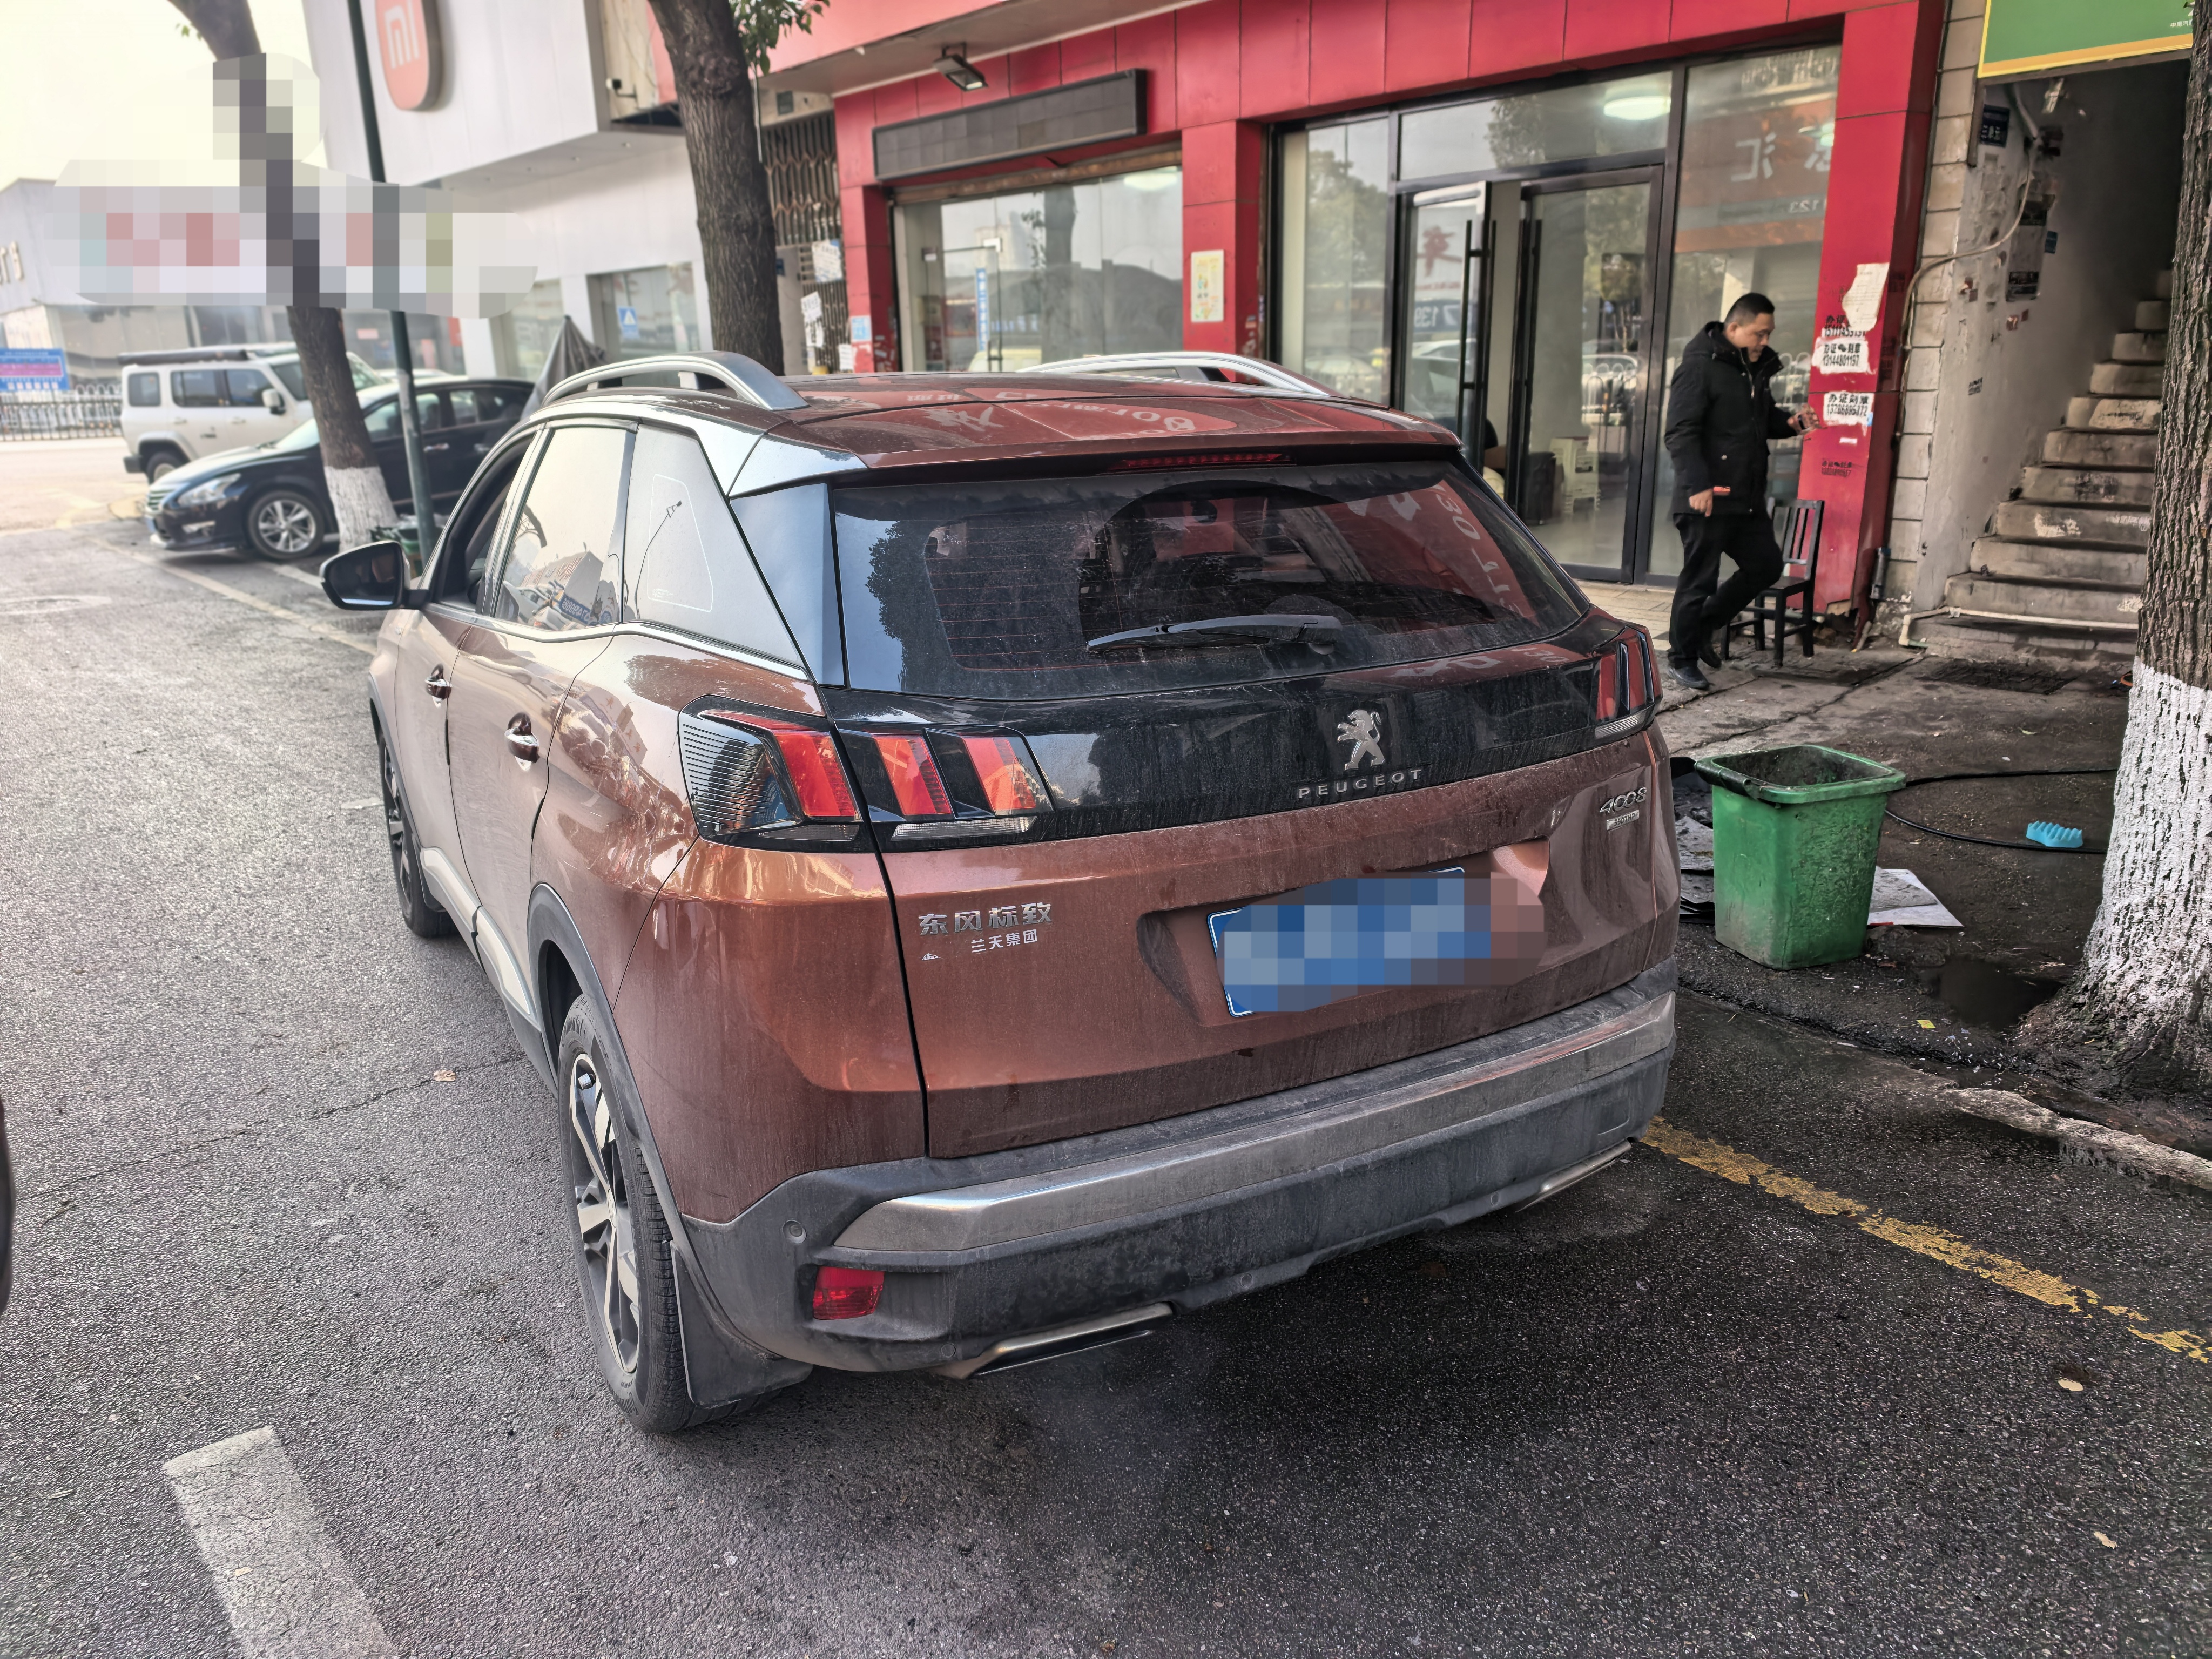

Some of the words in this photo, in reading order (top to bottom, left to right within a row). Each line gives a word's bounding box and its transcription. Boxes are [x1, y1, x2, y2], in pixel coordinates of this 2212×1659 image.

[1298, 769, 1421, 799] PEUGEOT
[1600, 786, 1648, 814] 4008
[918, 902, 1053, 935] 东风标致
[971, 929, 1038, 953] 兰天集团
